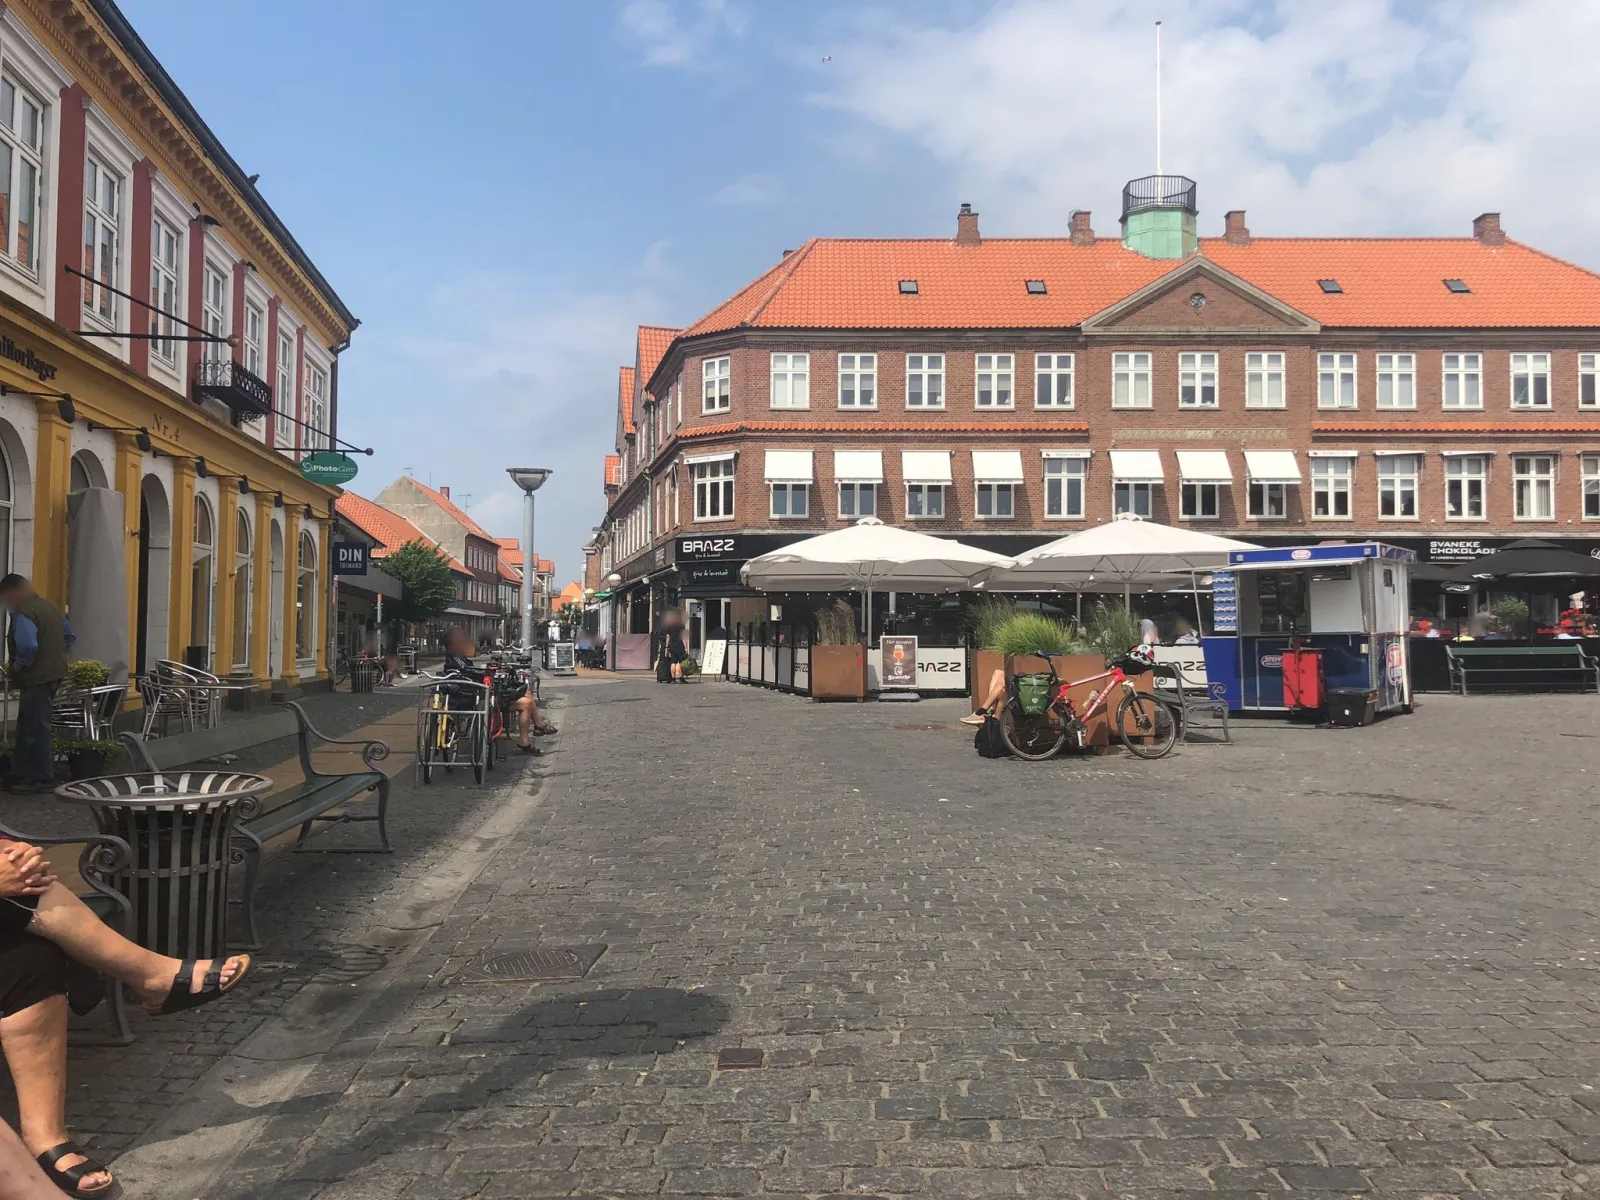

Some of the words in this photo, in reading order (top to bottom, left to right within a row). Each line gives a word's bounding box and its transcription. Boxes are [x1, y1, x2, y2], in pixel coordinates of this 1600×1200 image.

[682, 539, 735, 553] BRAZZ
[339, 548, 363, 562] DIN
[917, 662, 962, 673] RAZZ
